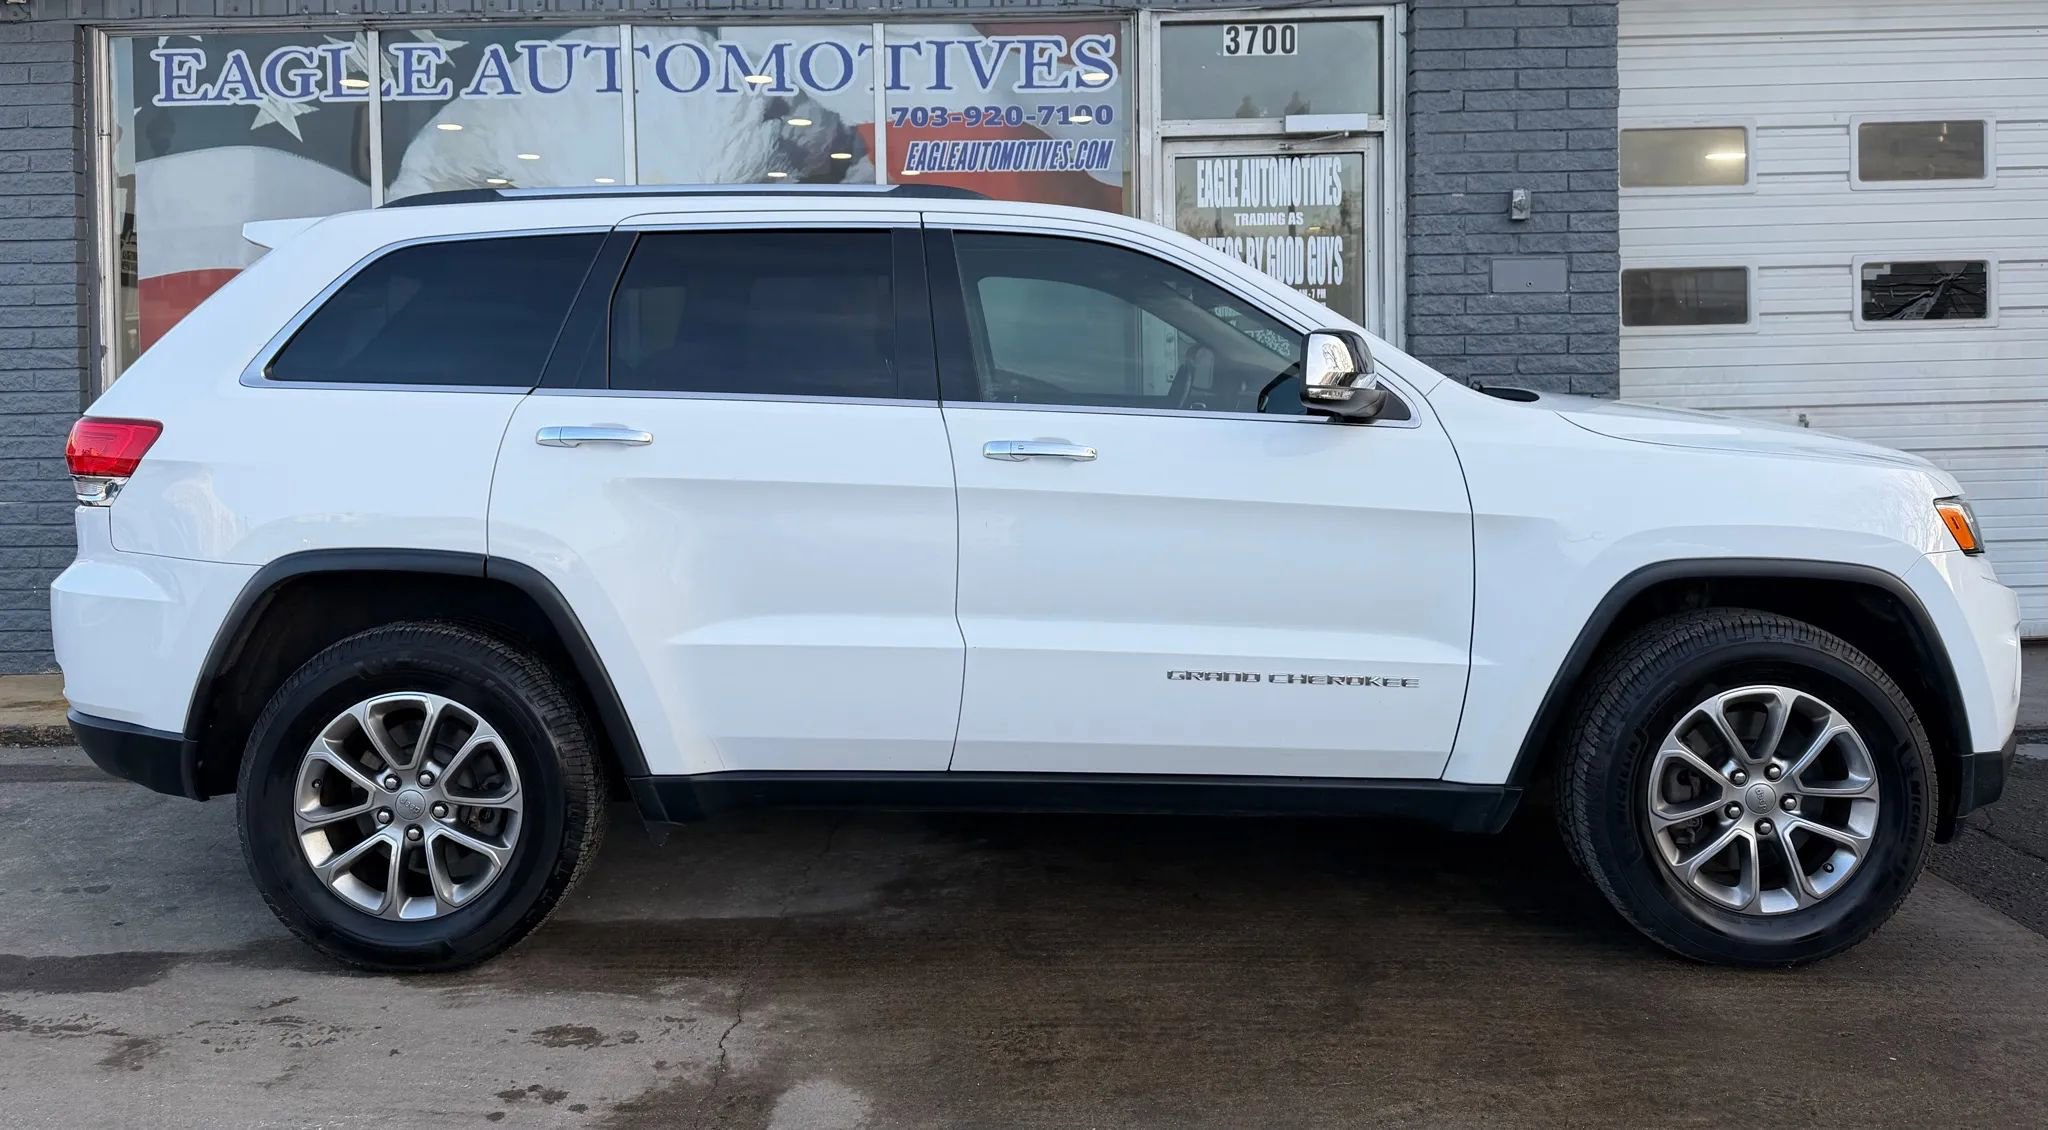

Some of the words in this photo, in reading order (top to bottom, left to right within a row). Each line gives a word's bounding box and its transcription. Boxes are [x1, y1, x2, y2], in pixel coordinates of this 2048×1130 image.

[1225, 24, 1296, 55] 3700
[153, 42, 452, 104] EAGLE
[465, 37, 1114, 96] AUTOMOTIVES
[891, 104, 1115, 127] 703-920-7100
[904, 139, 1115, 172] EAGLEAUTOMOTIVES.COM
[1197, 159, 1239, 208] EAGLE
[1240, 157, 1343, 208] AUTOMOTIVES
[1234, 212, 1286, 226] TRADING
[1288, 211, 1304, 225] AS
[1266, 235, 1304, 285] GOOD
[1307, 235, 1344, 285] GUYS
[1167, 670, 1261, 683] GRAND
[1268, 672, 1420, 688] CHEROKEE
